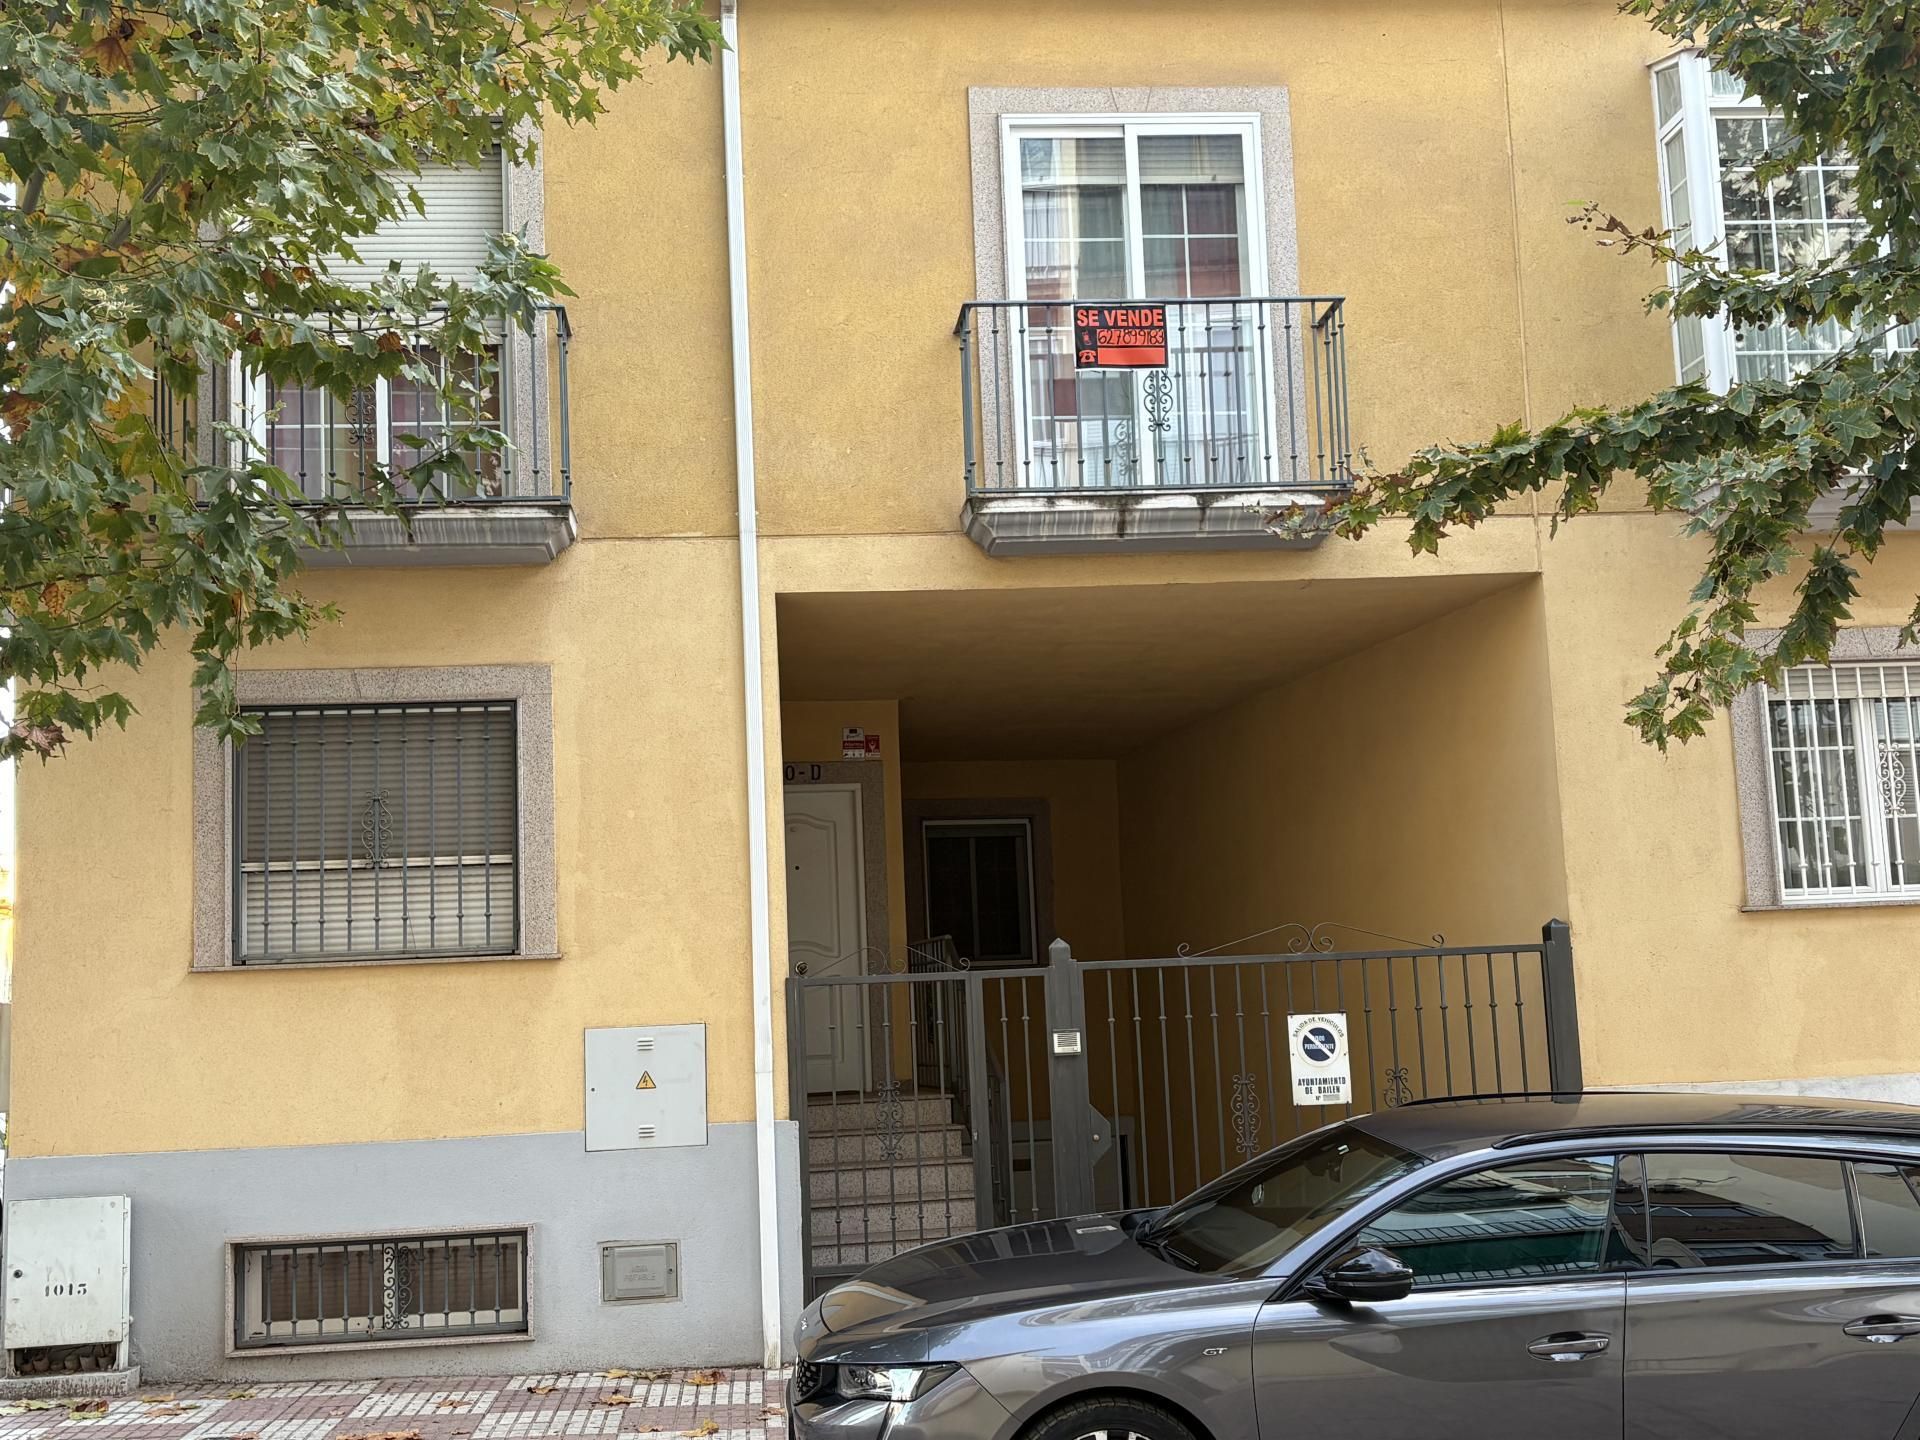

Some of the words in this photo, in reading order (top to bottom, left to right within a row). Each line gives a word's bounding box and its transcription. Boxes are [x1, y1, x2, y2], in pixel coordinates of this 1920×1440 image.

[1076, 308, 1100, 327] SE
[1103, 308, 1164, 327] VENDE
[1097, 329, 1165, 345] 627899183
[1293, 1020, 1308, 1037] SALIDA
[1318, 1017, 1344, 1037] VEHICULOS
[1298, 1077, 1346, 1086] AYUNTAMIENTO
[1318, 1085, 1340, 1094] BAILEN
[45, 1283, 88, 1297] 1015
[1202, 1347, 1228, 1356] GT
